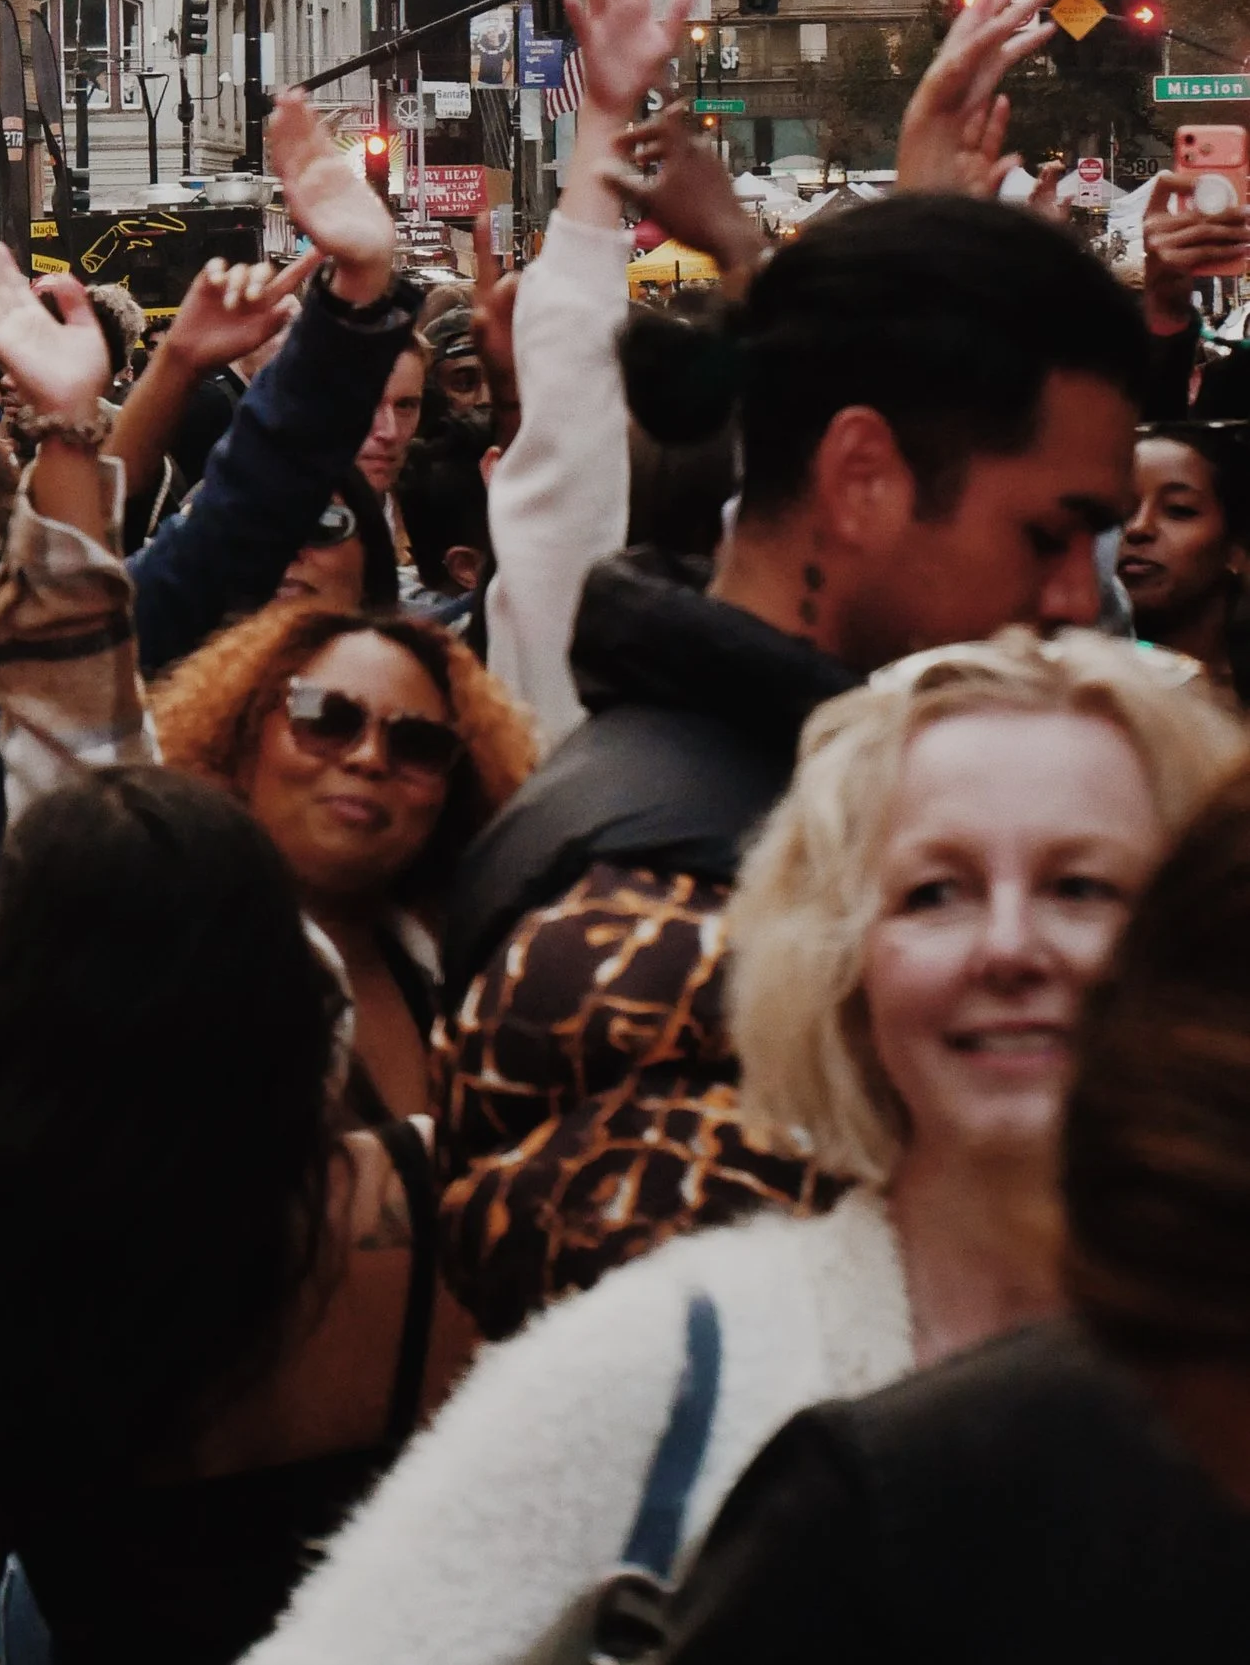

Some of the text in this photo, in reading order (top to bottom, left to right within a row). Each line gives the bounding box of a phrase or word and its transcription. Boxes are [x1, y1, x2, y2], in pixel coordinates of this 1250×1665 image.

[1167, 80, 1243, 96] Mission
[407, 169, 478, 180] GRY HEAD
[410, 229, 440, 240] Town
[34, 258, 63, 273] Lumpia
